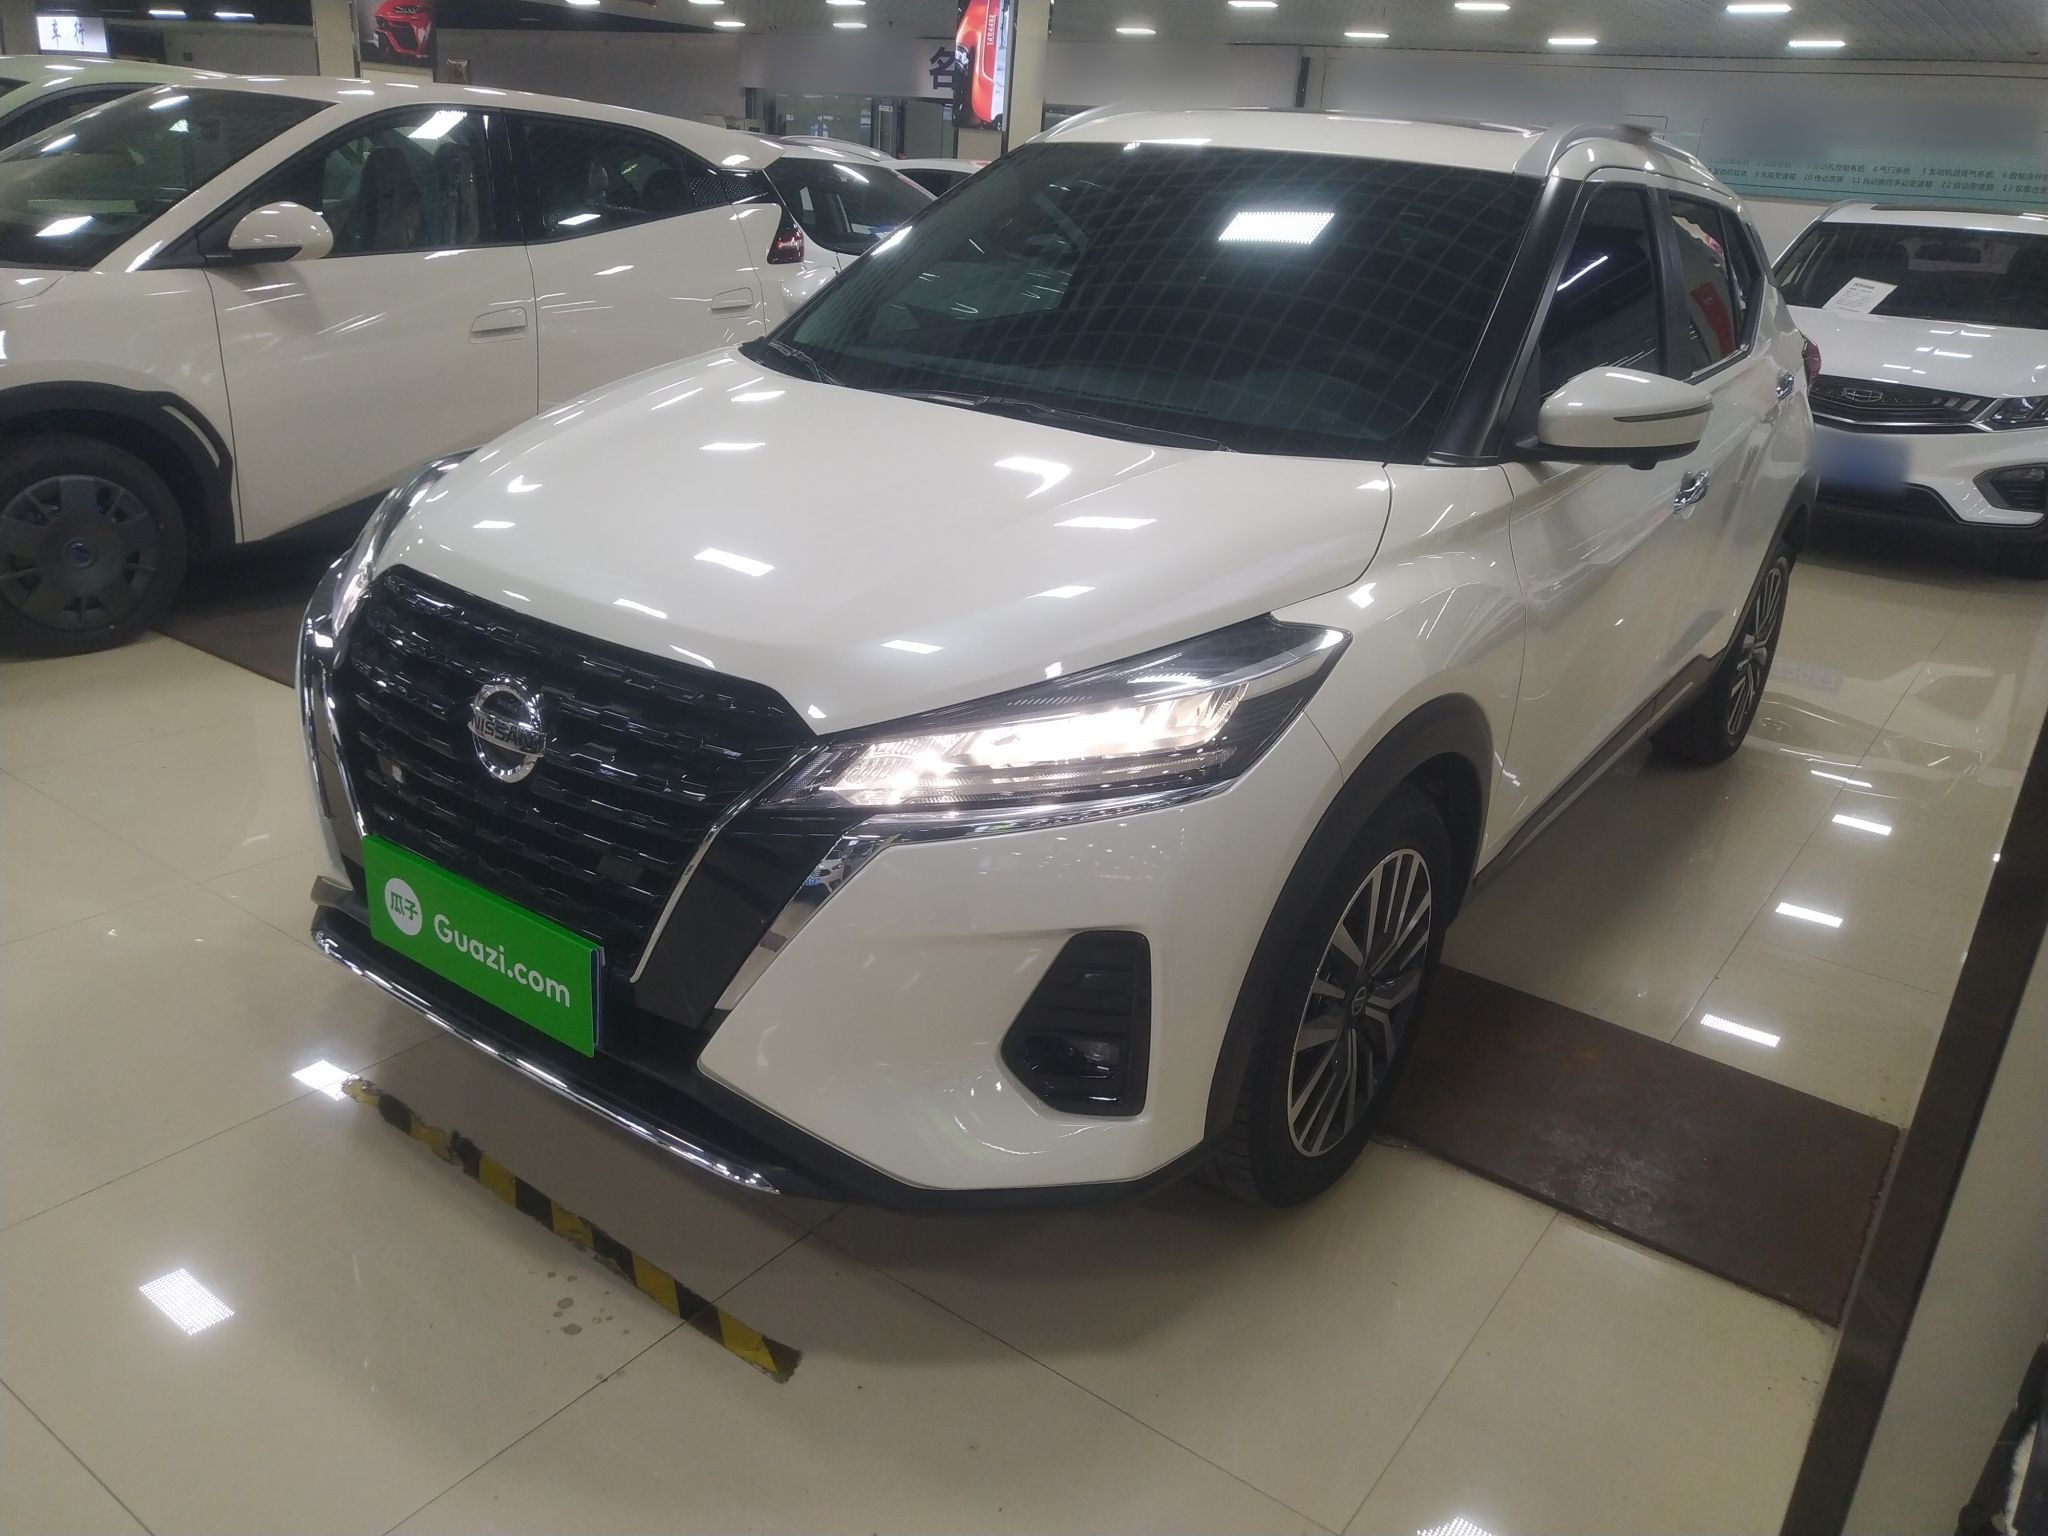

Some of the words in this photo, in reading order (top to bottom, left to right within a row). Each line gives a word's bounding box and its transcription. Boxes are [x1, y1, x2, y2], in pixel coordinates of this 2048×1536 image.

[470, 715, 541, 753] NISSAN
[390, 891, 418, 920] 瓜子
[434, 914, 570, 1008] Guazi.com
